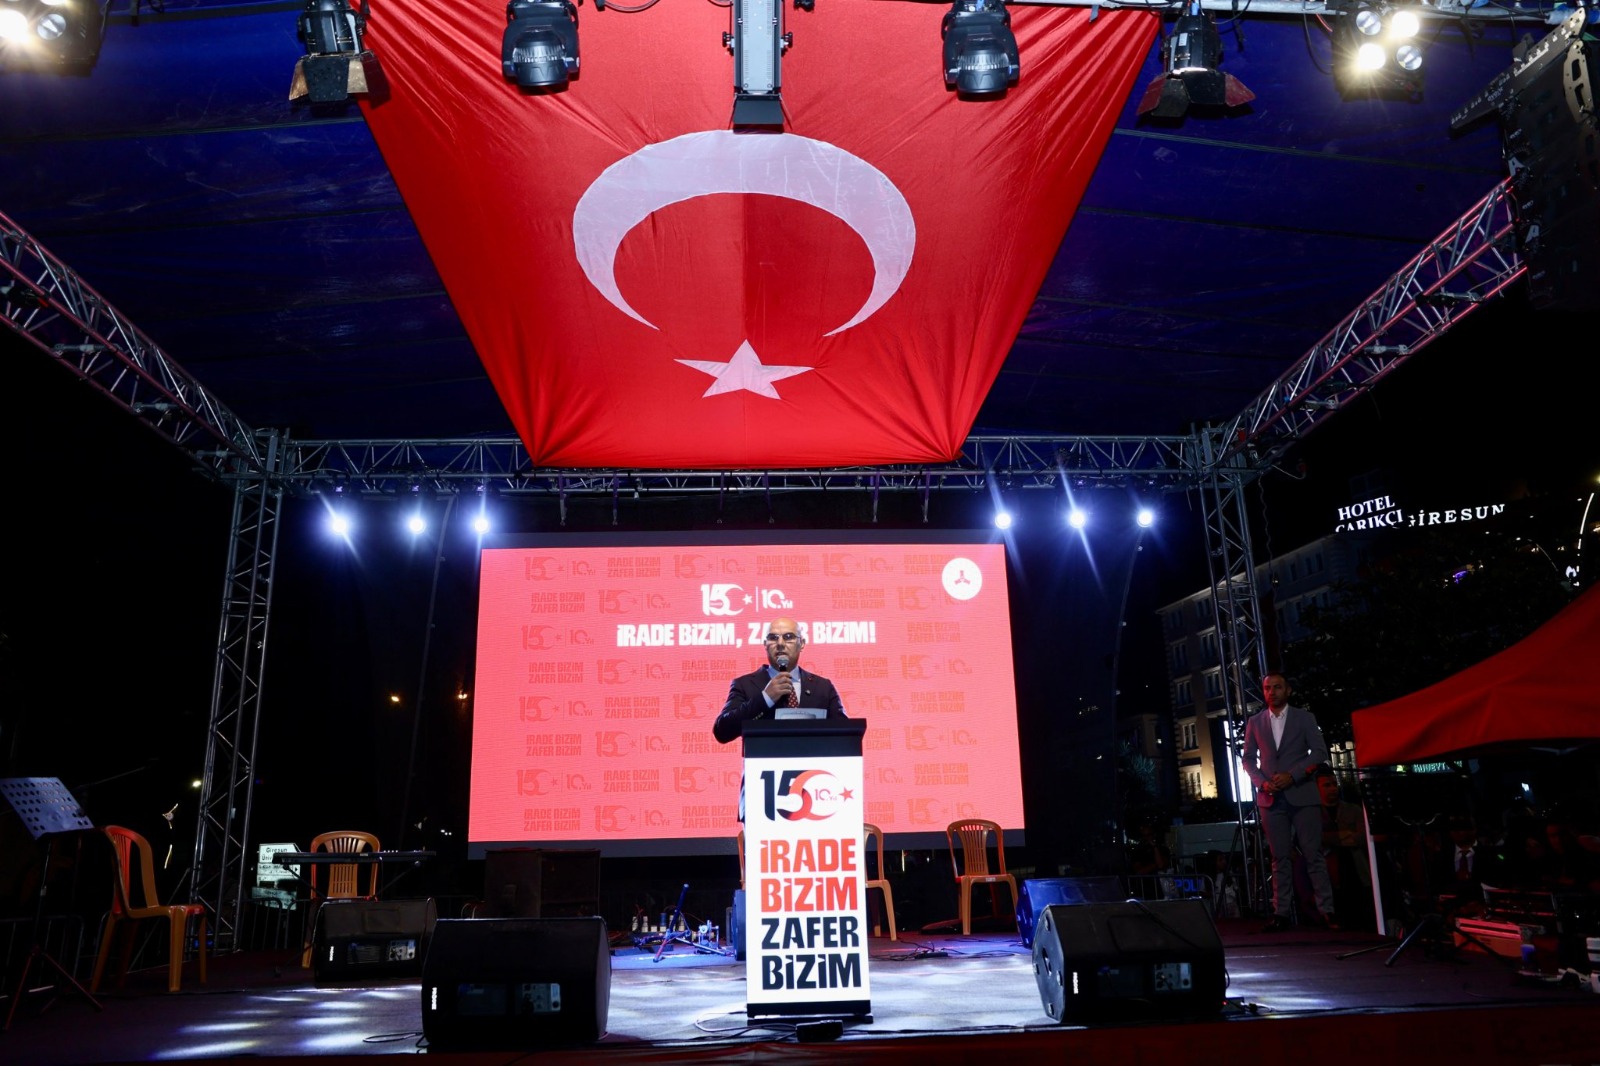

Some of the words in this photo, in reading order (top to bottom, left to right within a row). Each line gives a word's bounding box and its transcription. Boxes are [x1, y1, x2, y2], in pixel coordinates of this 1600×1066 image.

[1338, 495, 1396, 520] HOTEL
[701, 584, 730, 616] 15
[617, 624, 674, 647] İRADE
[679, 623, 742, 648] BİZİM,
[812, 621, 876, 644] BİZİM!
[760, 770, 812, 821] 15
[760, 839, 856, 873] İRADE
[761, 877, 858, 912] BİZİM
[762, 916, 859, 949] ZAFER
[762, 953, 861, 990] BİZİM
